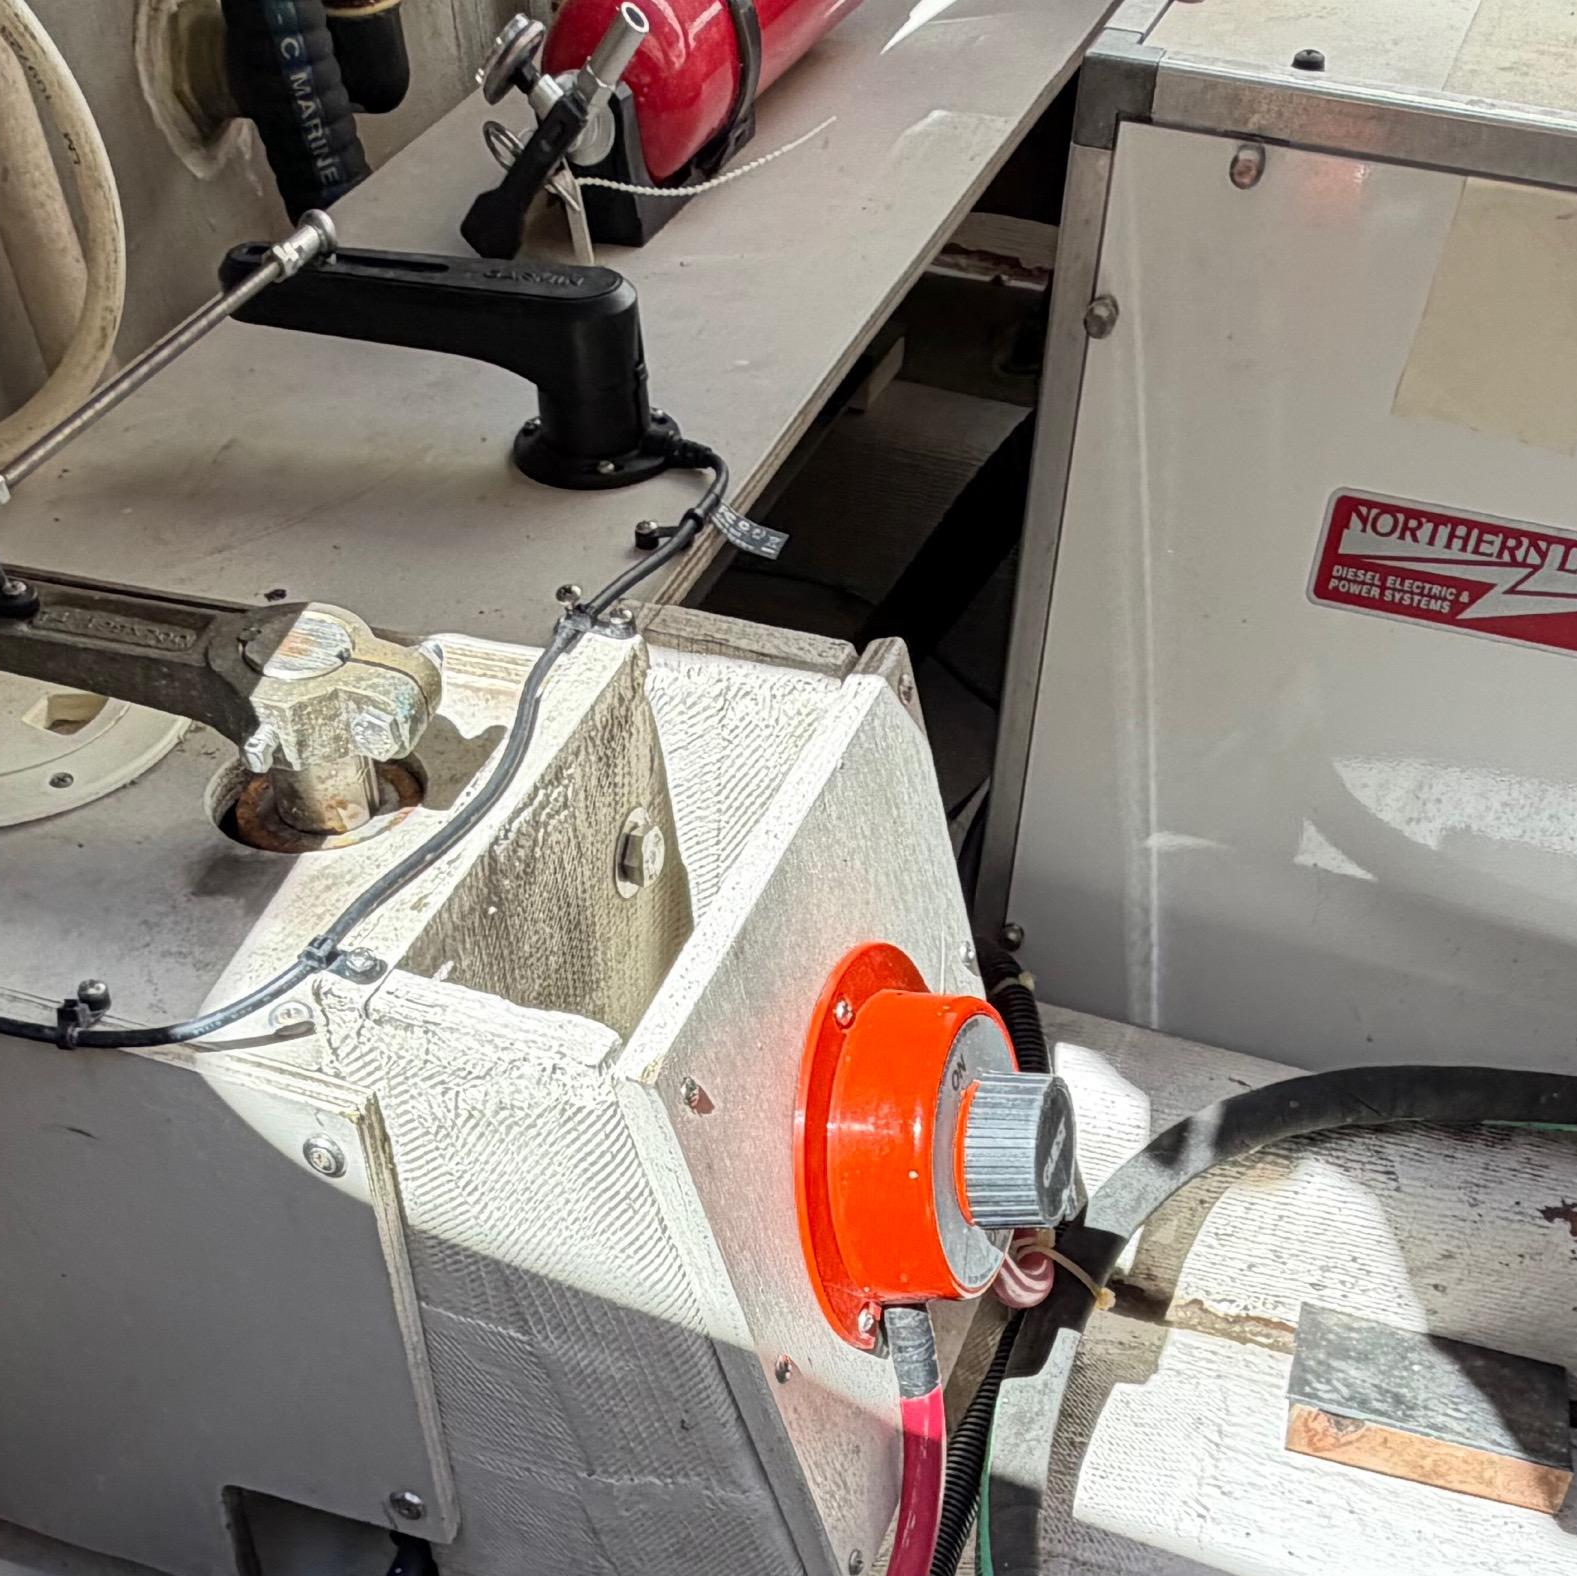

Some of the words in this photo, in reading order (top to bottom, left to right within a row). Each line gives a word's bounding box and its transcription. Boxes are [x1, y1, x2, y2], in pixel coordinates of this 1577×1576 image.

[290, 71, 340, 185] MARINE
[1344, 506, 1548, 567] NORTHERN
[1328, 578, 1381, 601] POWER
[1383, 587, 1451, 615] SYSTEMS
[1332, 564, 1383, 587] DIESEL
[1385, 575, 1456, 601] ELECTRIC
[1457, 591, 1470, 605] &
[951, 1053, 967, 1092] ON
